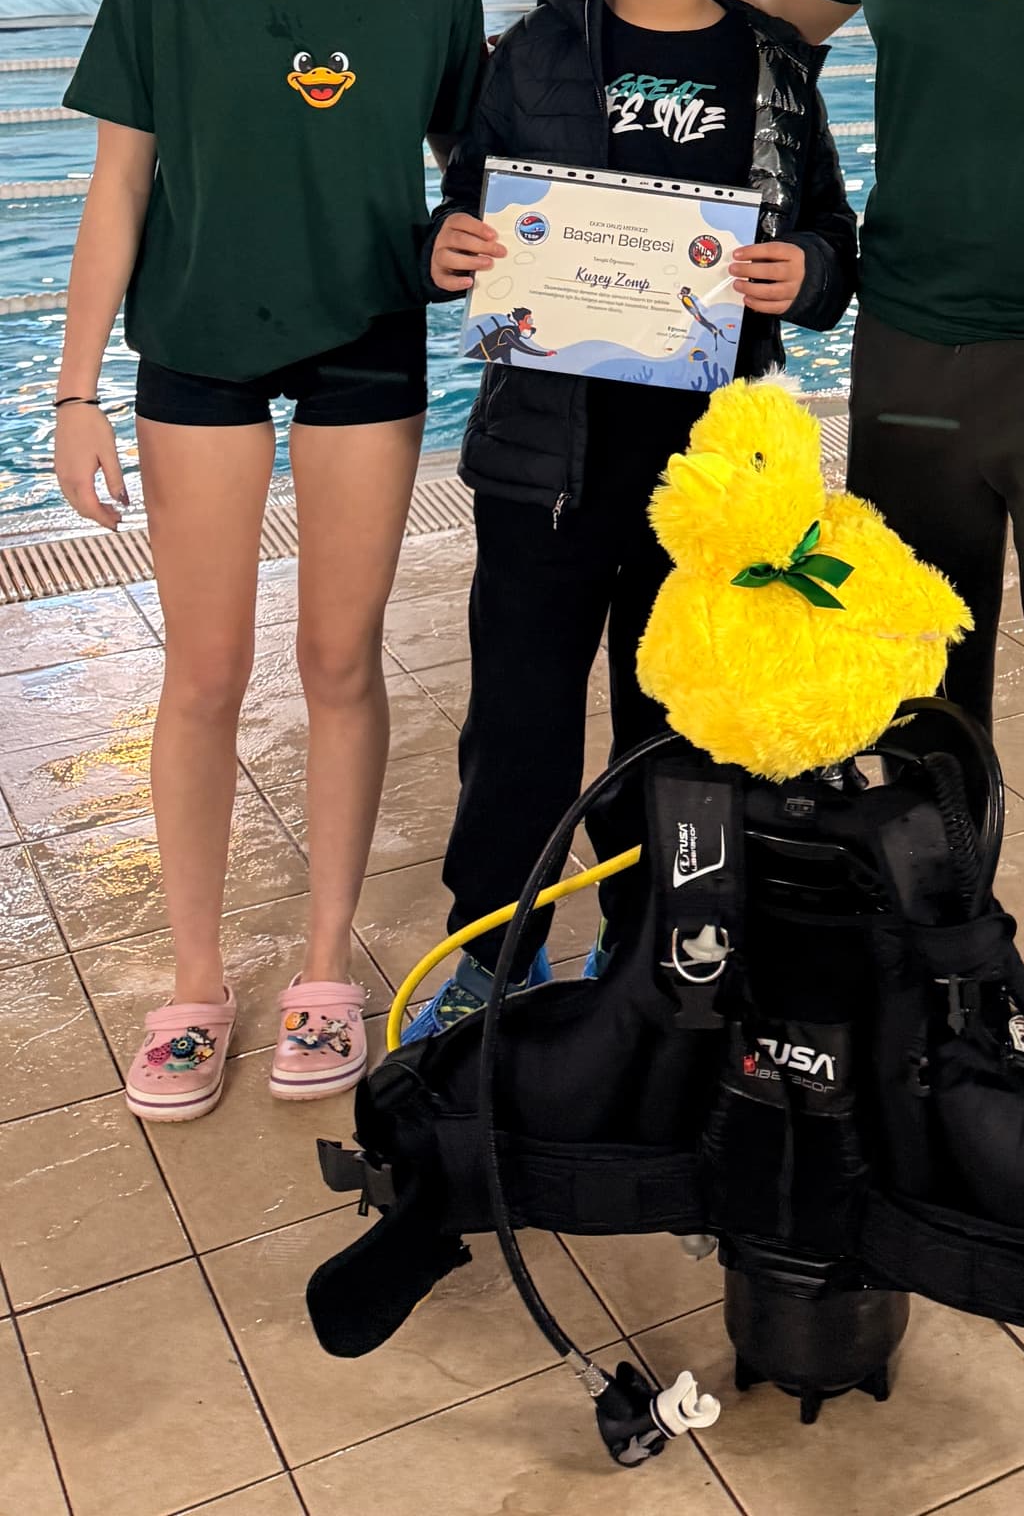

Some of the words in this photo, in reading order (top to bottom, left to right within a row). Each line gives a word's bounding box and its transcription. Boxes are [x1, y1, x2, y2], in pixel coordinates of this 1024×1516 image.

[607, 72, 717, 105] GREAT
[645, 93, 726, 144] STYLE
[563, 226, 615, 245] Başarı
[618, 233, 675, 253] Belgesi
[575, 266, 612, 289] Kuzey
